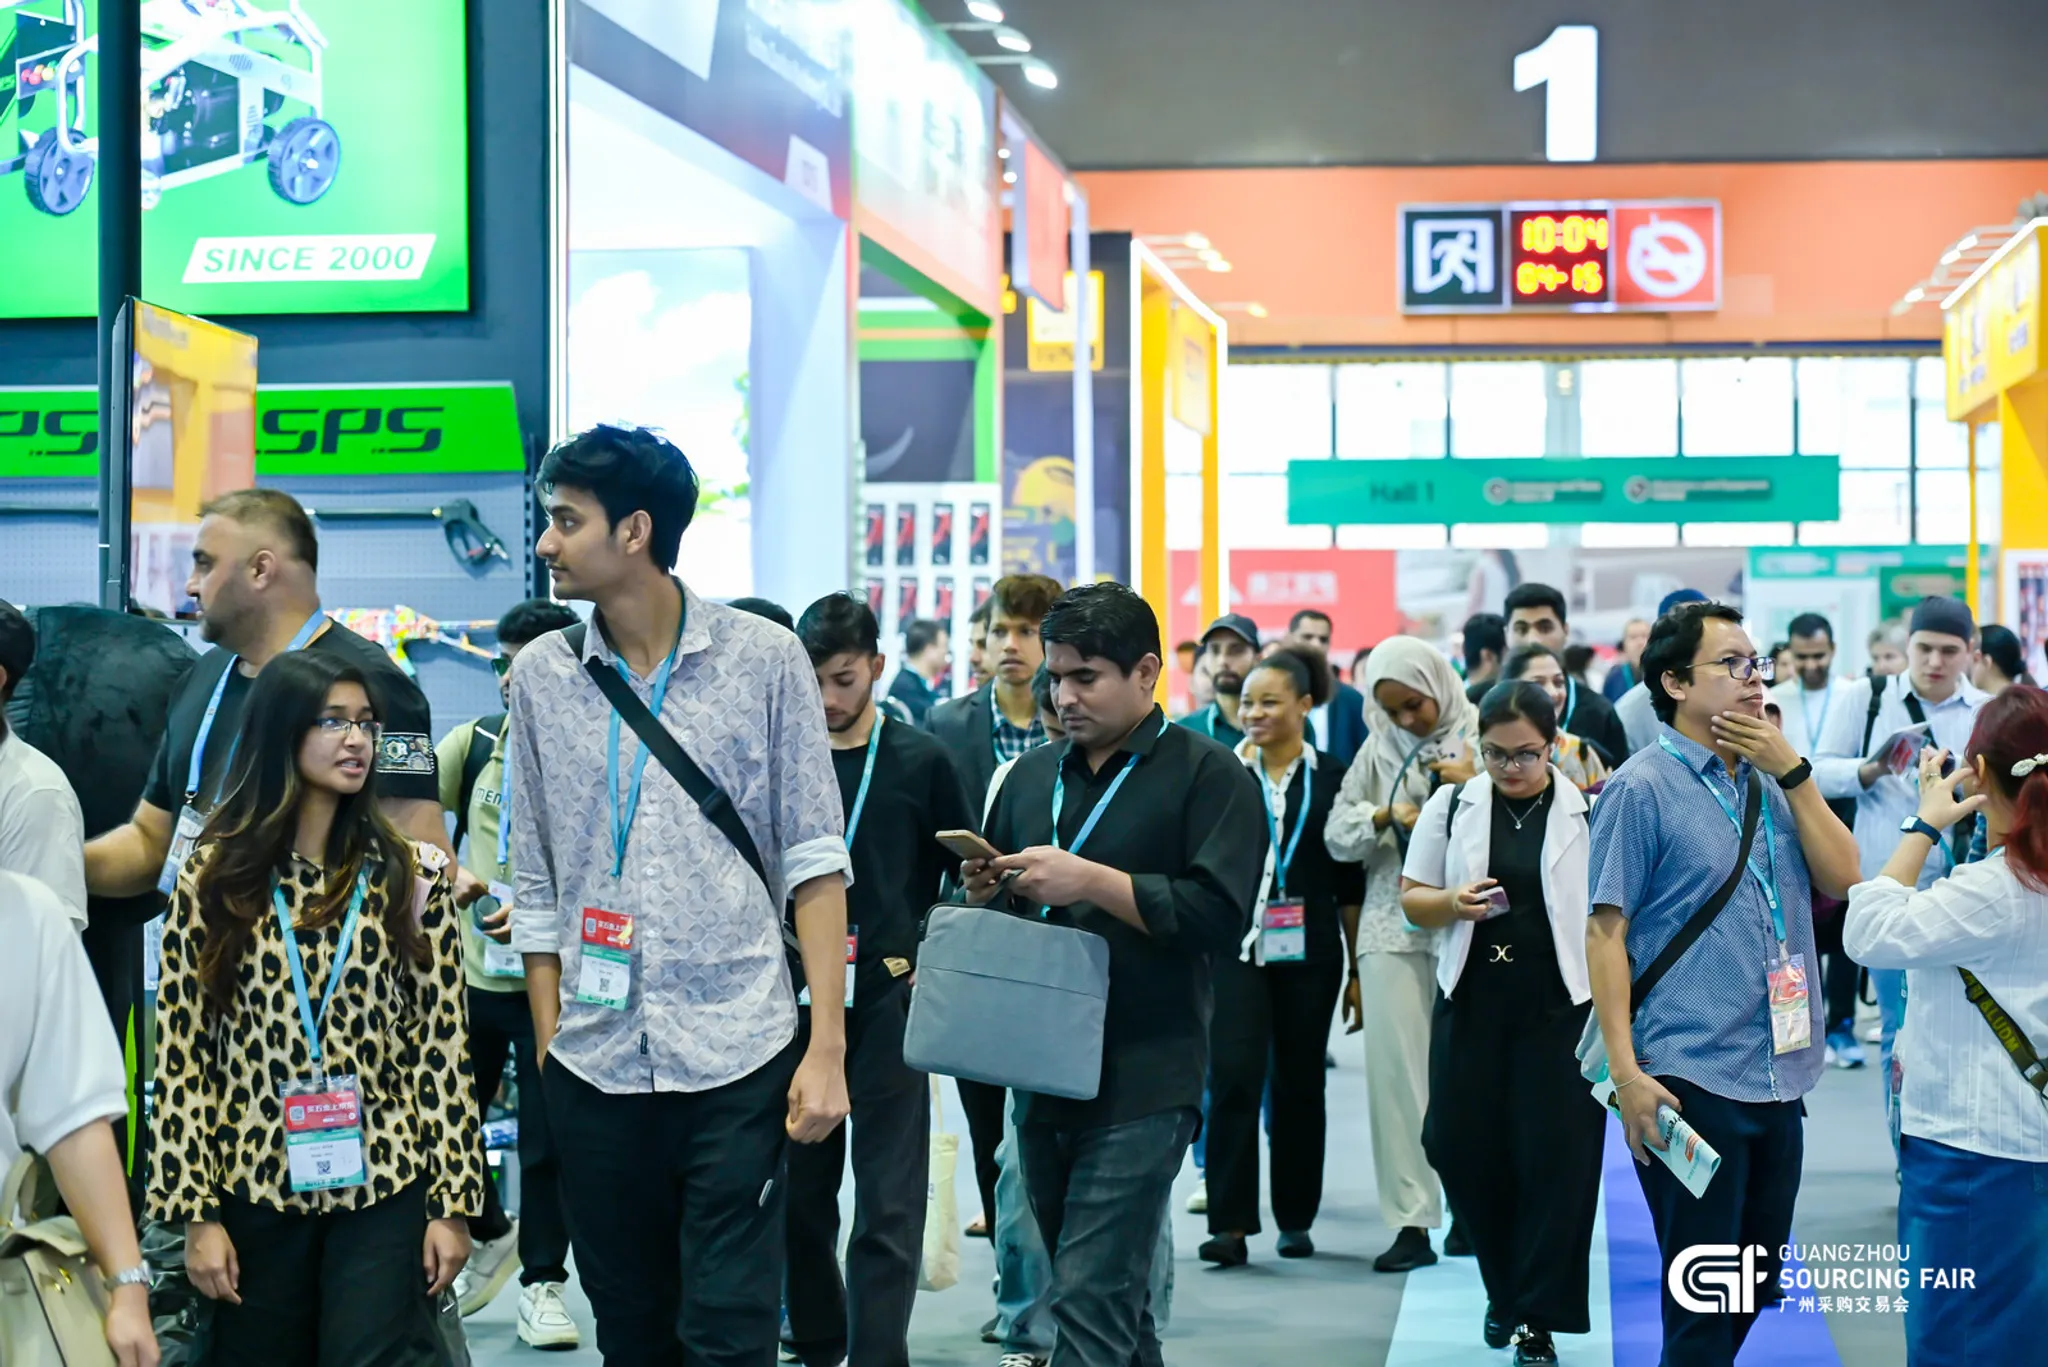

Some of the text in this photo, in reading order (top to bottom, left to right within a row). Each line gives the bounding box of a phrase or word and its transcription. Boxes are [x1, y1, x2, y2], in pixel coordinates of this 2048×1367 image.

[1514, 25, 1598, 162] 1
[1522, 215, 1609, 253] 10:04
[204, 246, 414, 272] SINCE 2000
